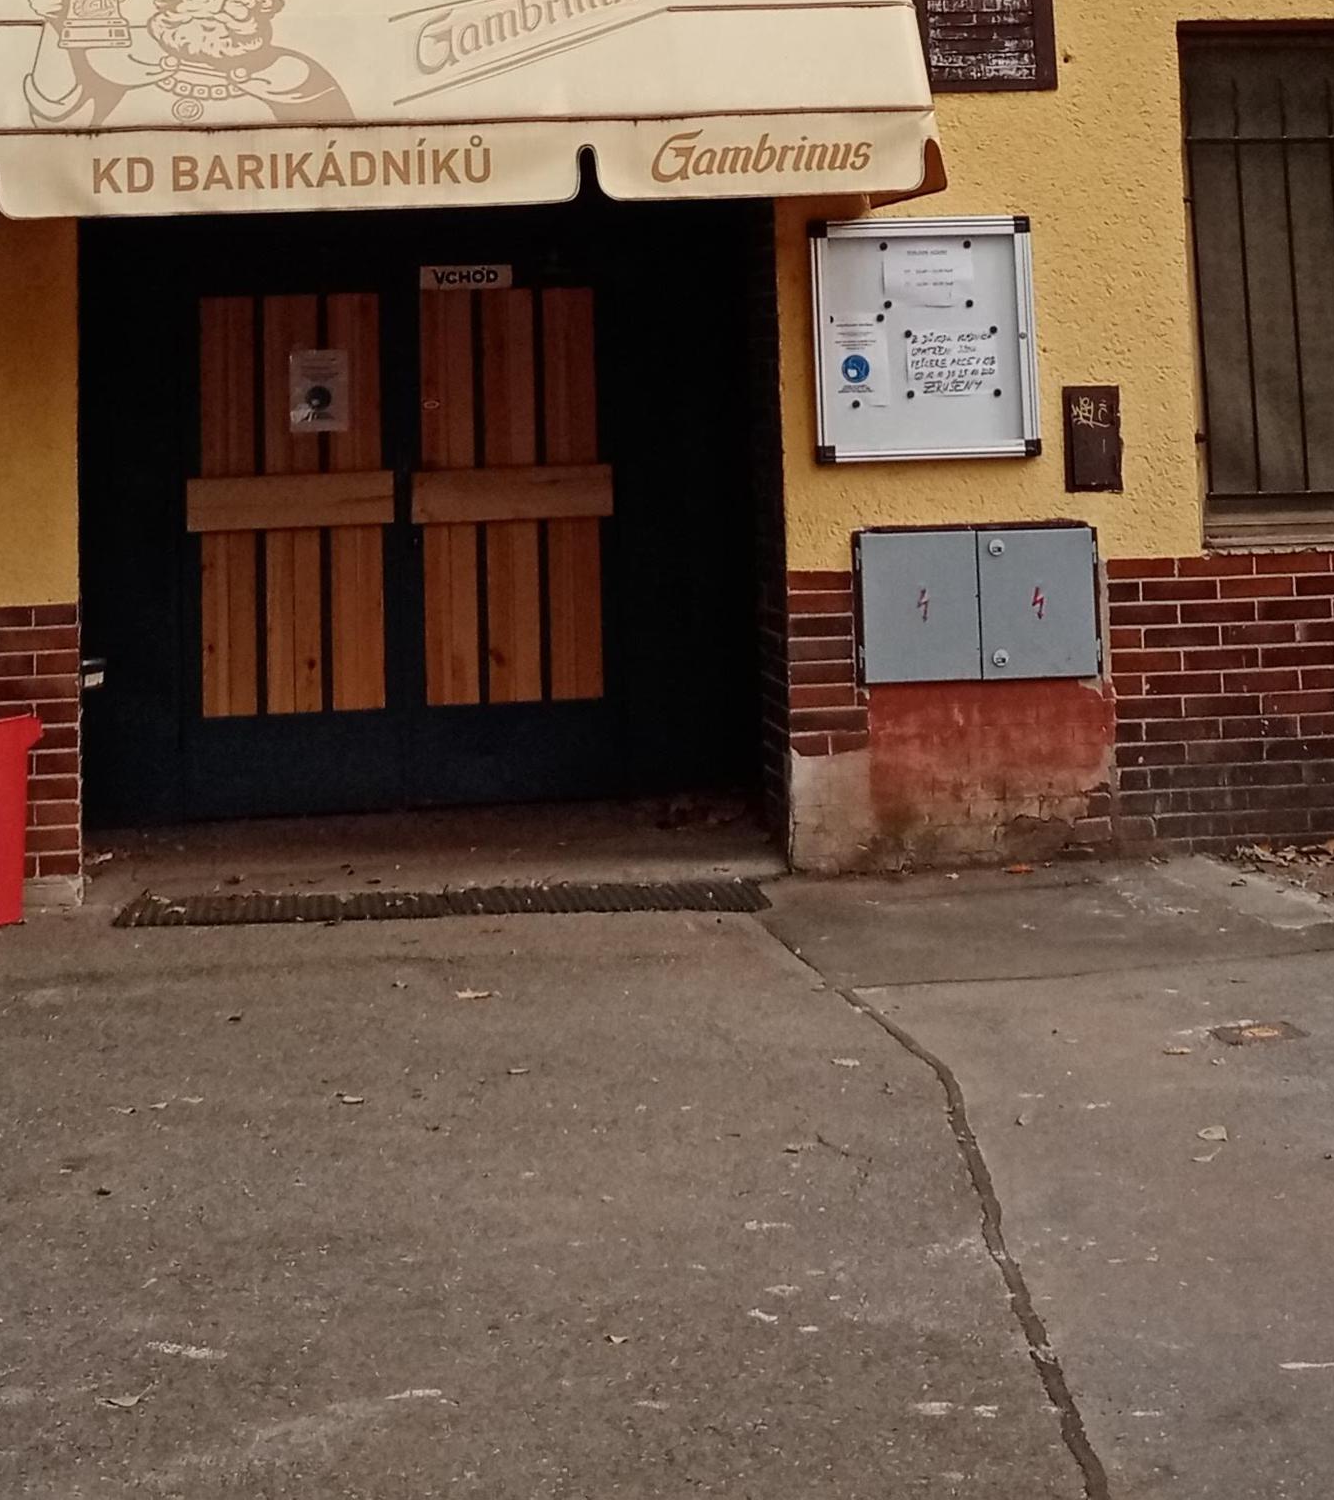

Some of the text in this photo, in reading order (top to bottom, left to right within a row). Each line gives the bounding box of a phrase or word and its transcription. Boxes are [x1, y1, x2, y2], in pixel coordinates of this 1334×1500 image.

[92, 136, 491, 195] KD BARIKÁDNÍKŮ
[651, 128, 873, 184] Gambrinus
